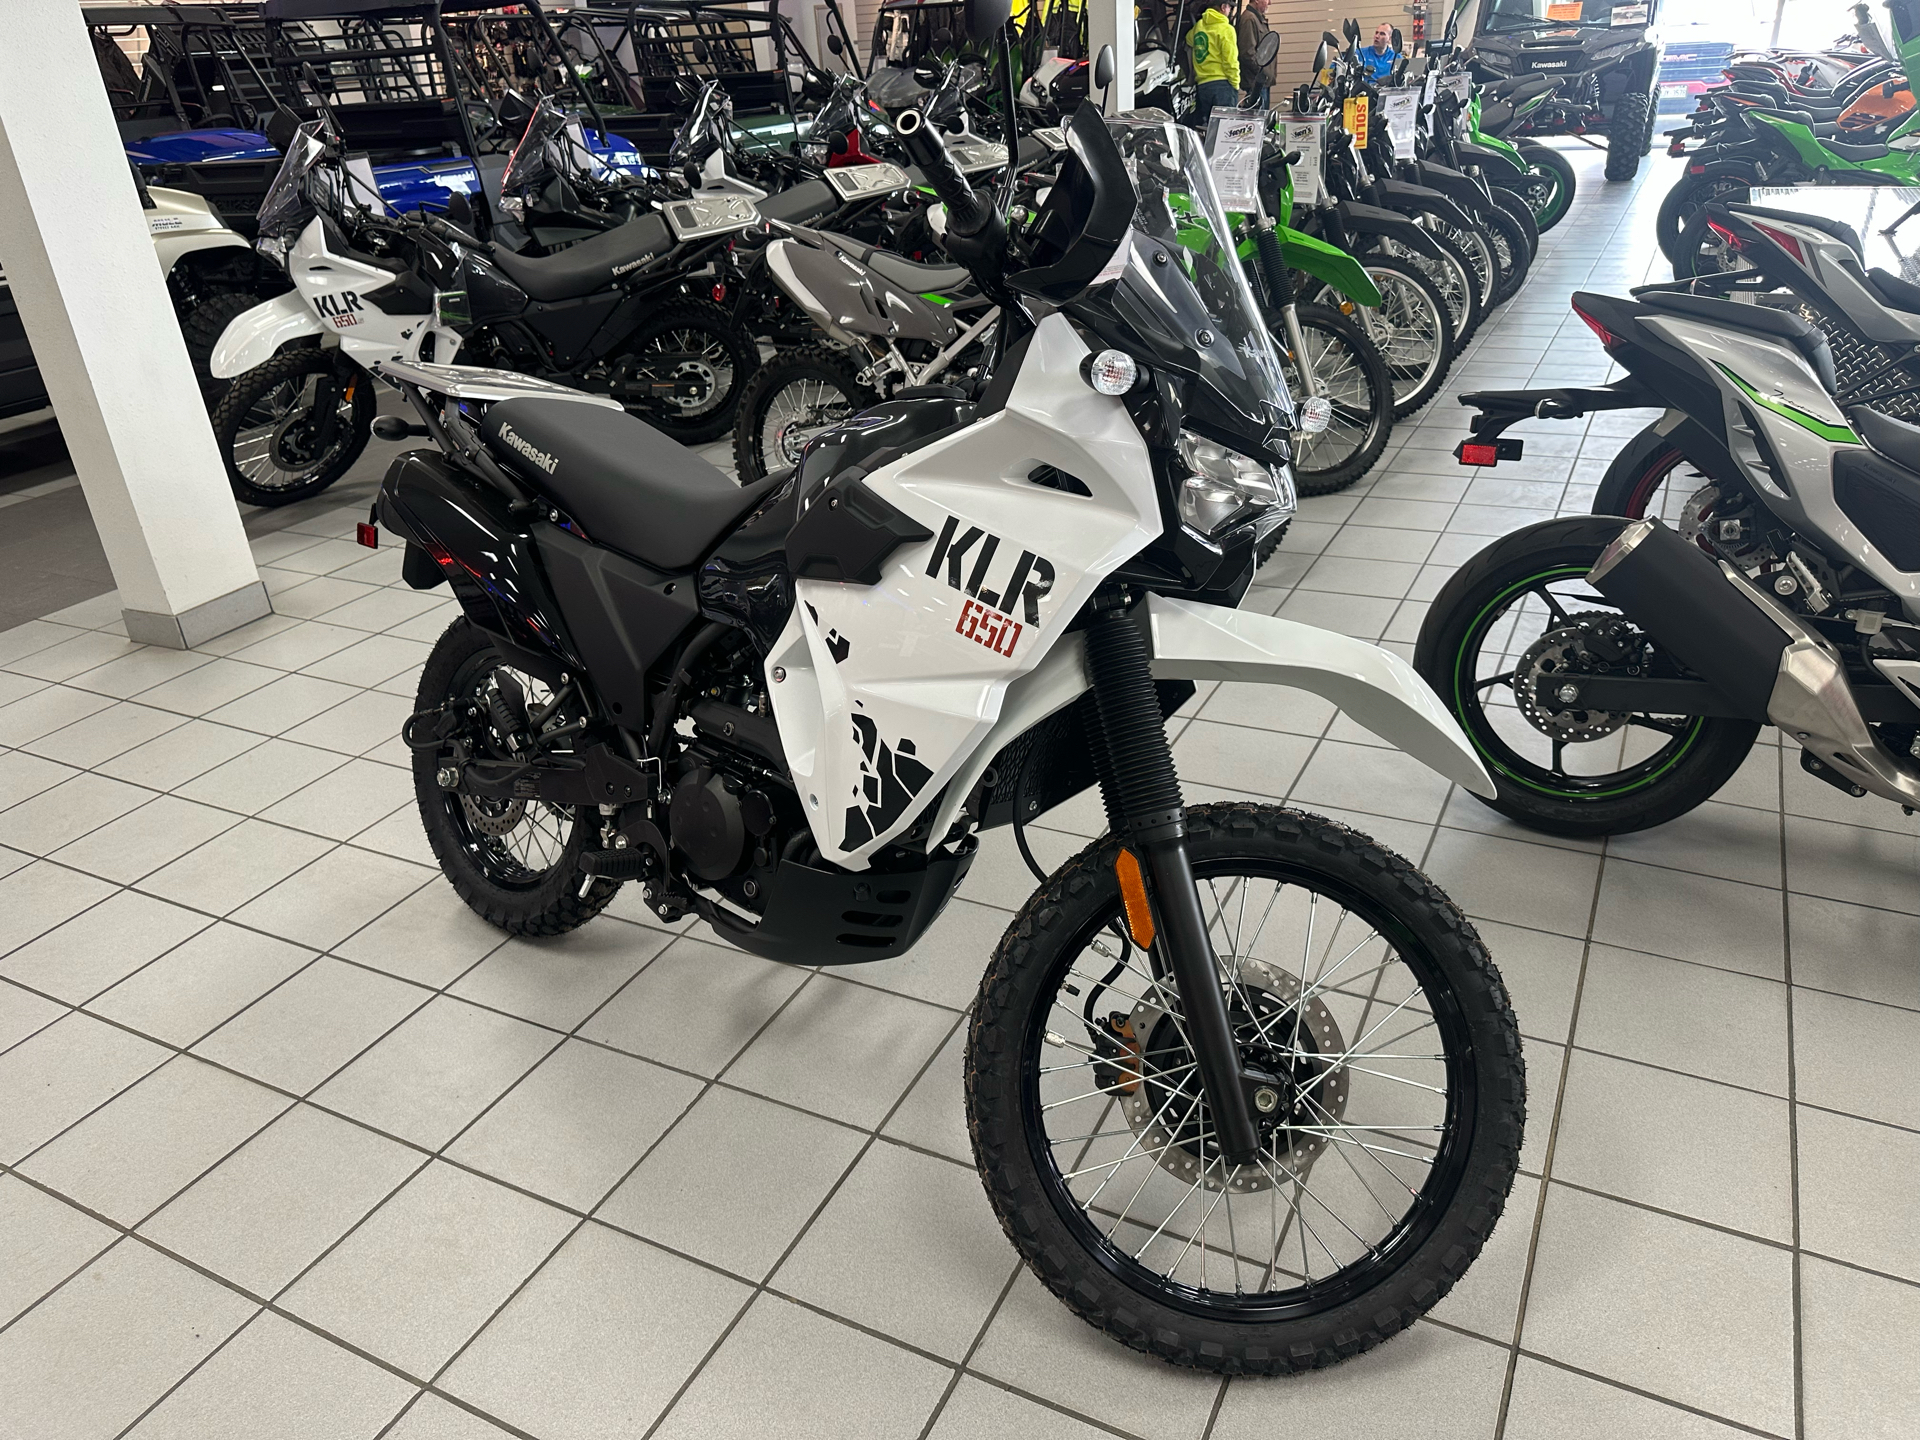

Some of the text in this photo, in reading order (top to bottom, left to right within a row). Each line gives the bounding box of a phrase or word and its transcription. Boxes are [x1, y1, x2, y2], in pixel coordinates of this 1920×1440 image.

[1531, 60, 1568, 69] Kawasaki
[1355, 103, 1366, 141] SOLD
[612, 252, 656, 276] Kawasaki
[312, 290, 364, 318] KLR
[332, 313, 359, 329] 650
[498, 421, 560, 475] Kawasaki
[925, 514, 1056, 629] KLR
[955, 599, 1023, 659] 650
